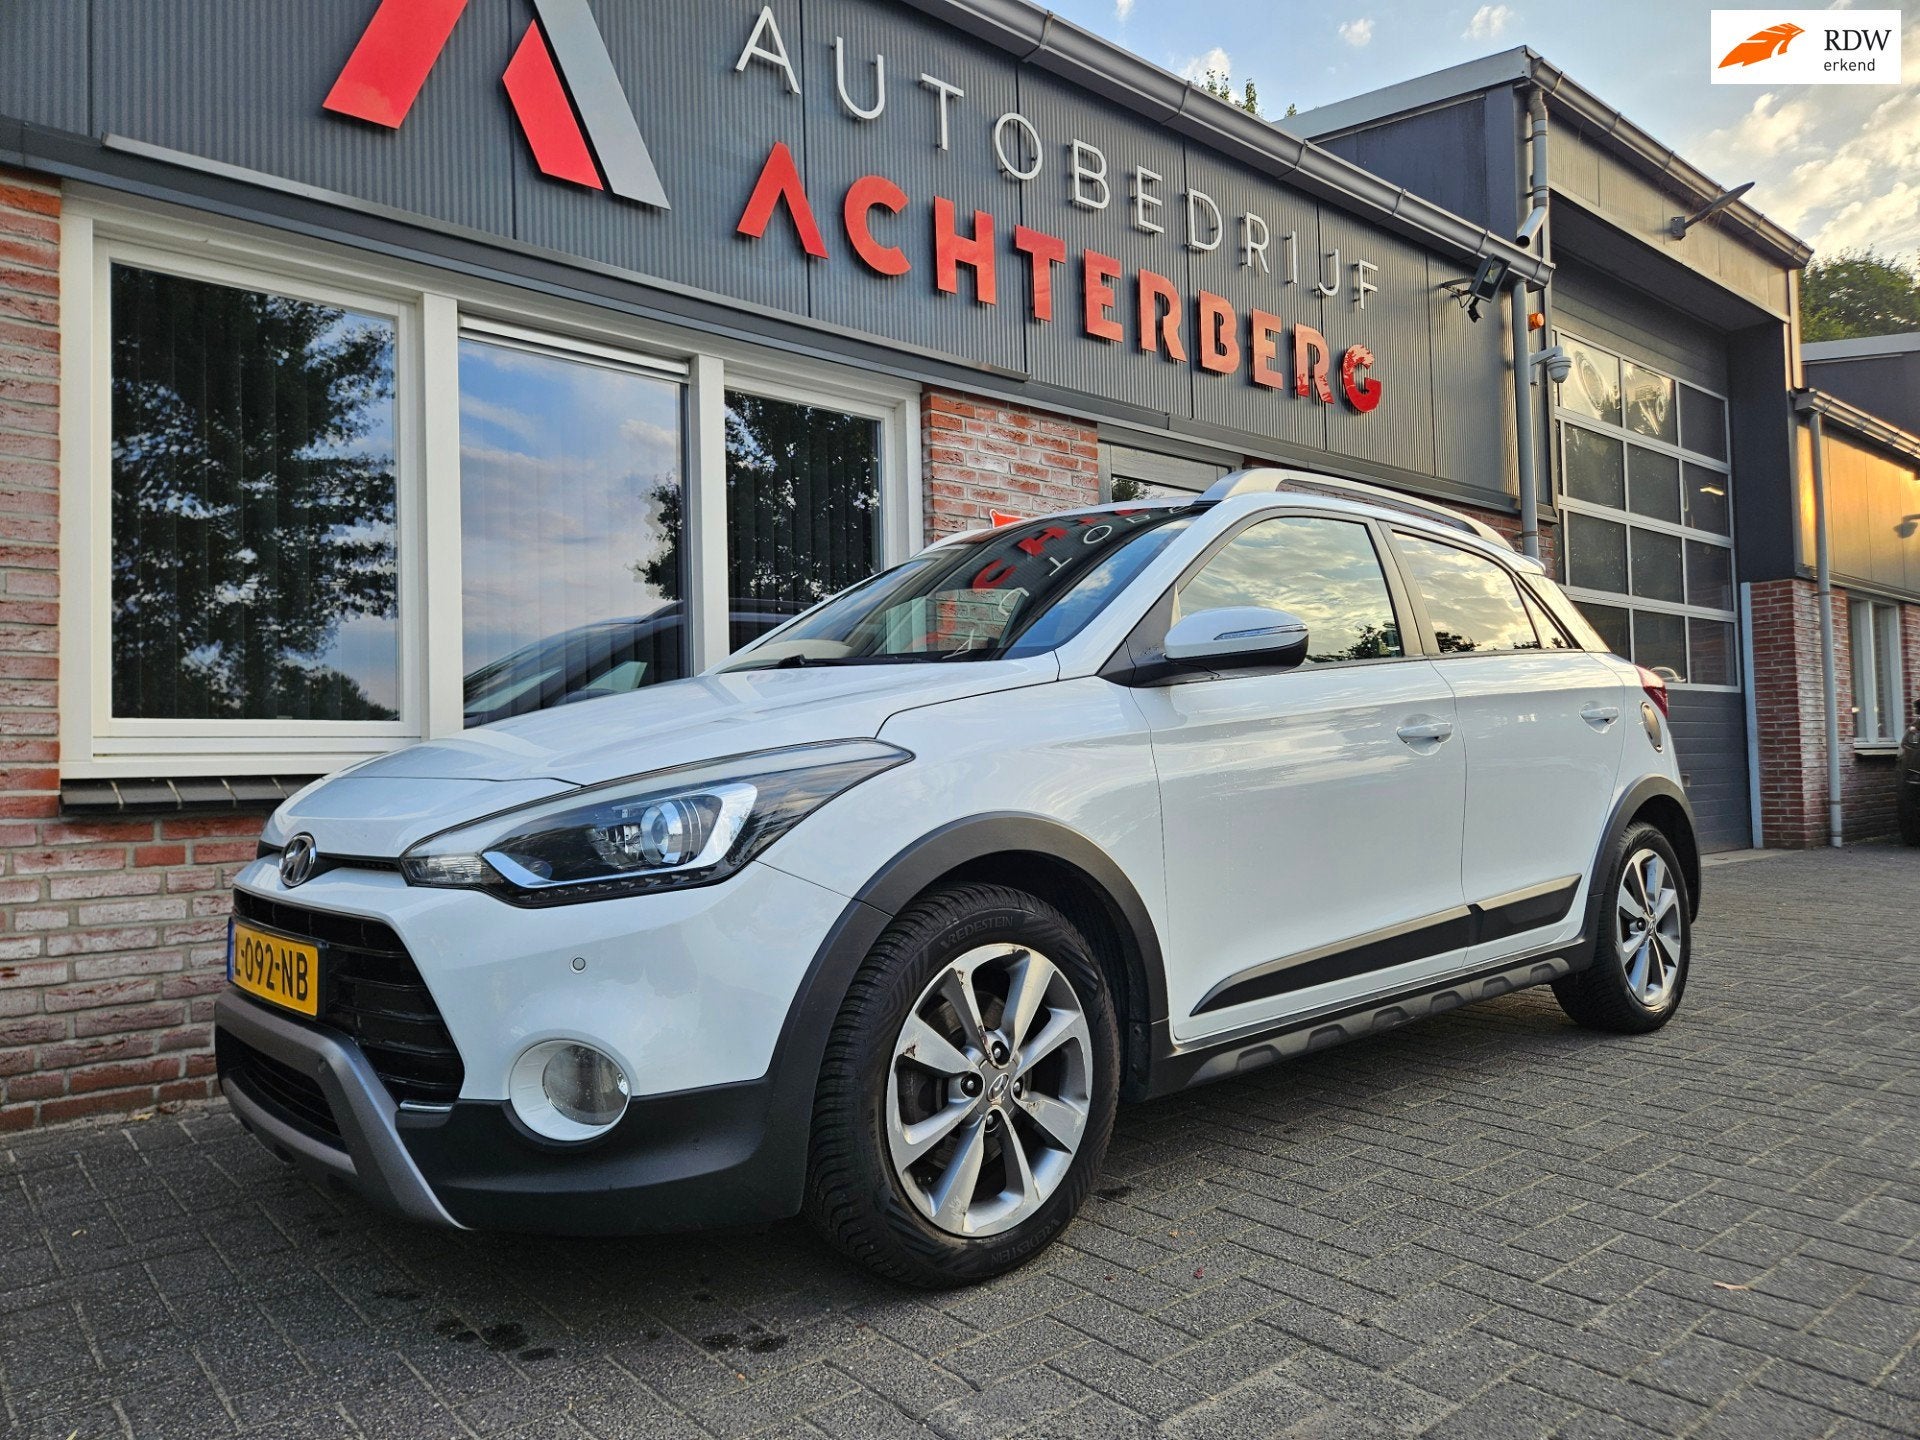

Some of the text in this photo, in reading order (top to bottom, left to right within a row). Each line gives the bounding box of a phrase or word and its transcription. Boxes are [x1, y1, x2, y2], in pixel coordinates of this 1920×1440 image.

[735, 5, 1380, 310] AUTOBEDRIJF
[736, 141, 1383, 414] ACHTERBERG
[234, 931, 309, 1002] L-092-NB
